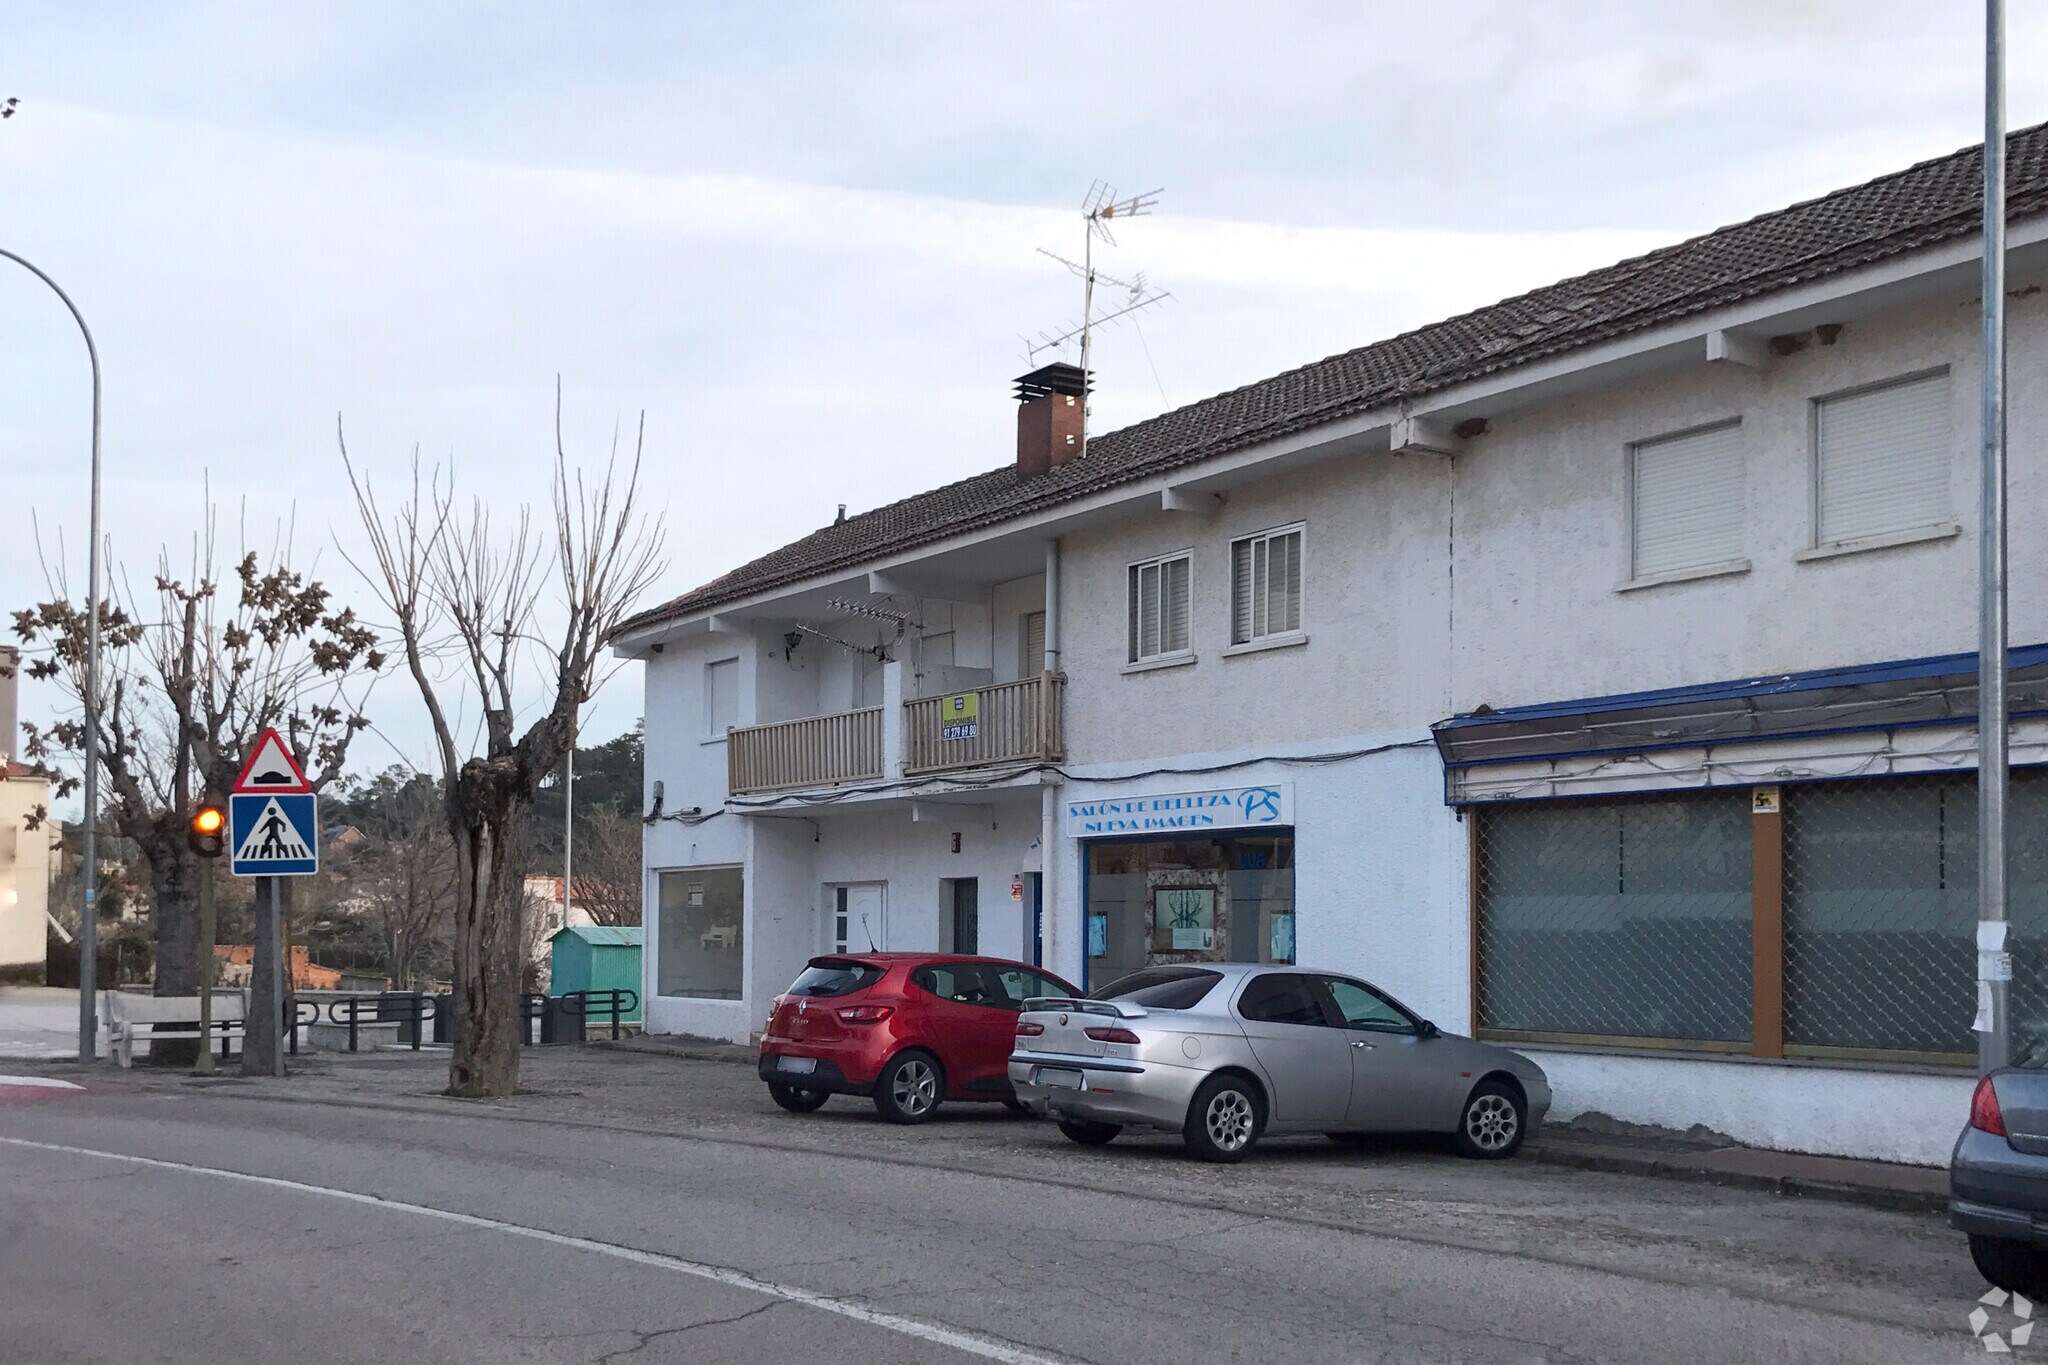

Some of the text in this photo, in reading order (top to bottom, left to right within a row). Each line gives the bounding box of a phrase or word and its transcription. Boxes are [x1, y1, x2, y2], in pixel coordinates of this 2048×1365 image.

[944, 728, 950, 738] 91
[1070, 795, 1231, 817] SALÓN DE BELLEZA
[1085, 814, 1214, 832] NUEVA IMAGEN
